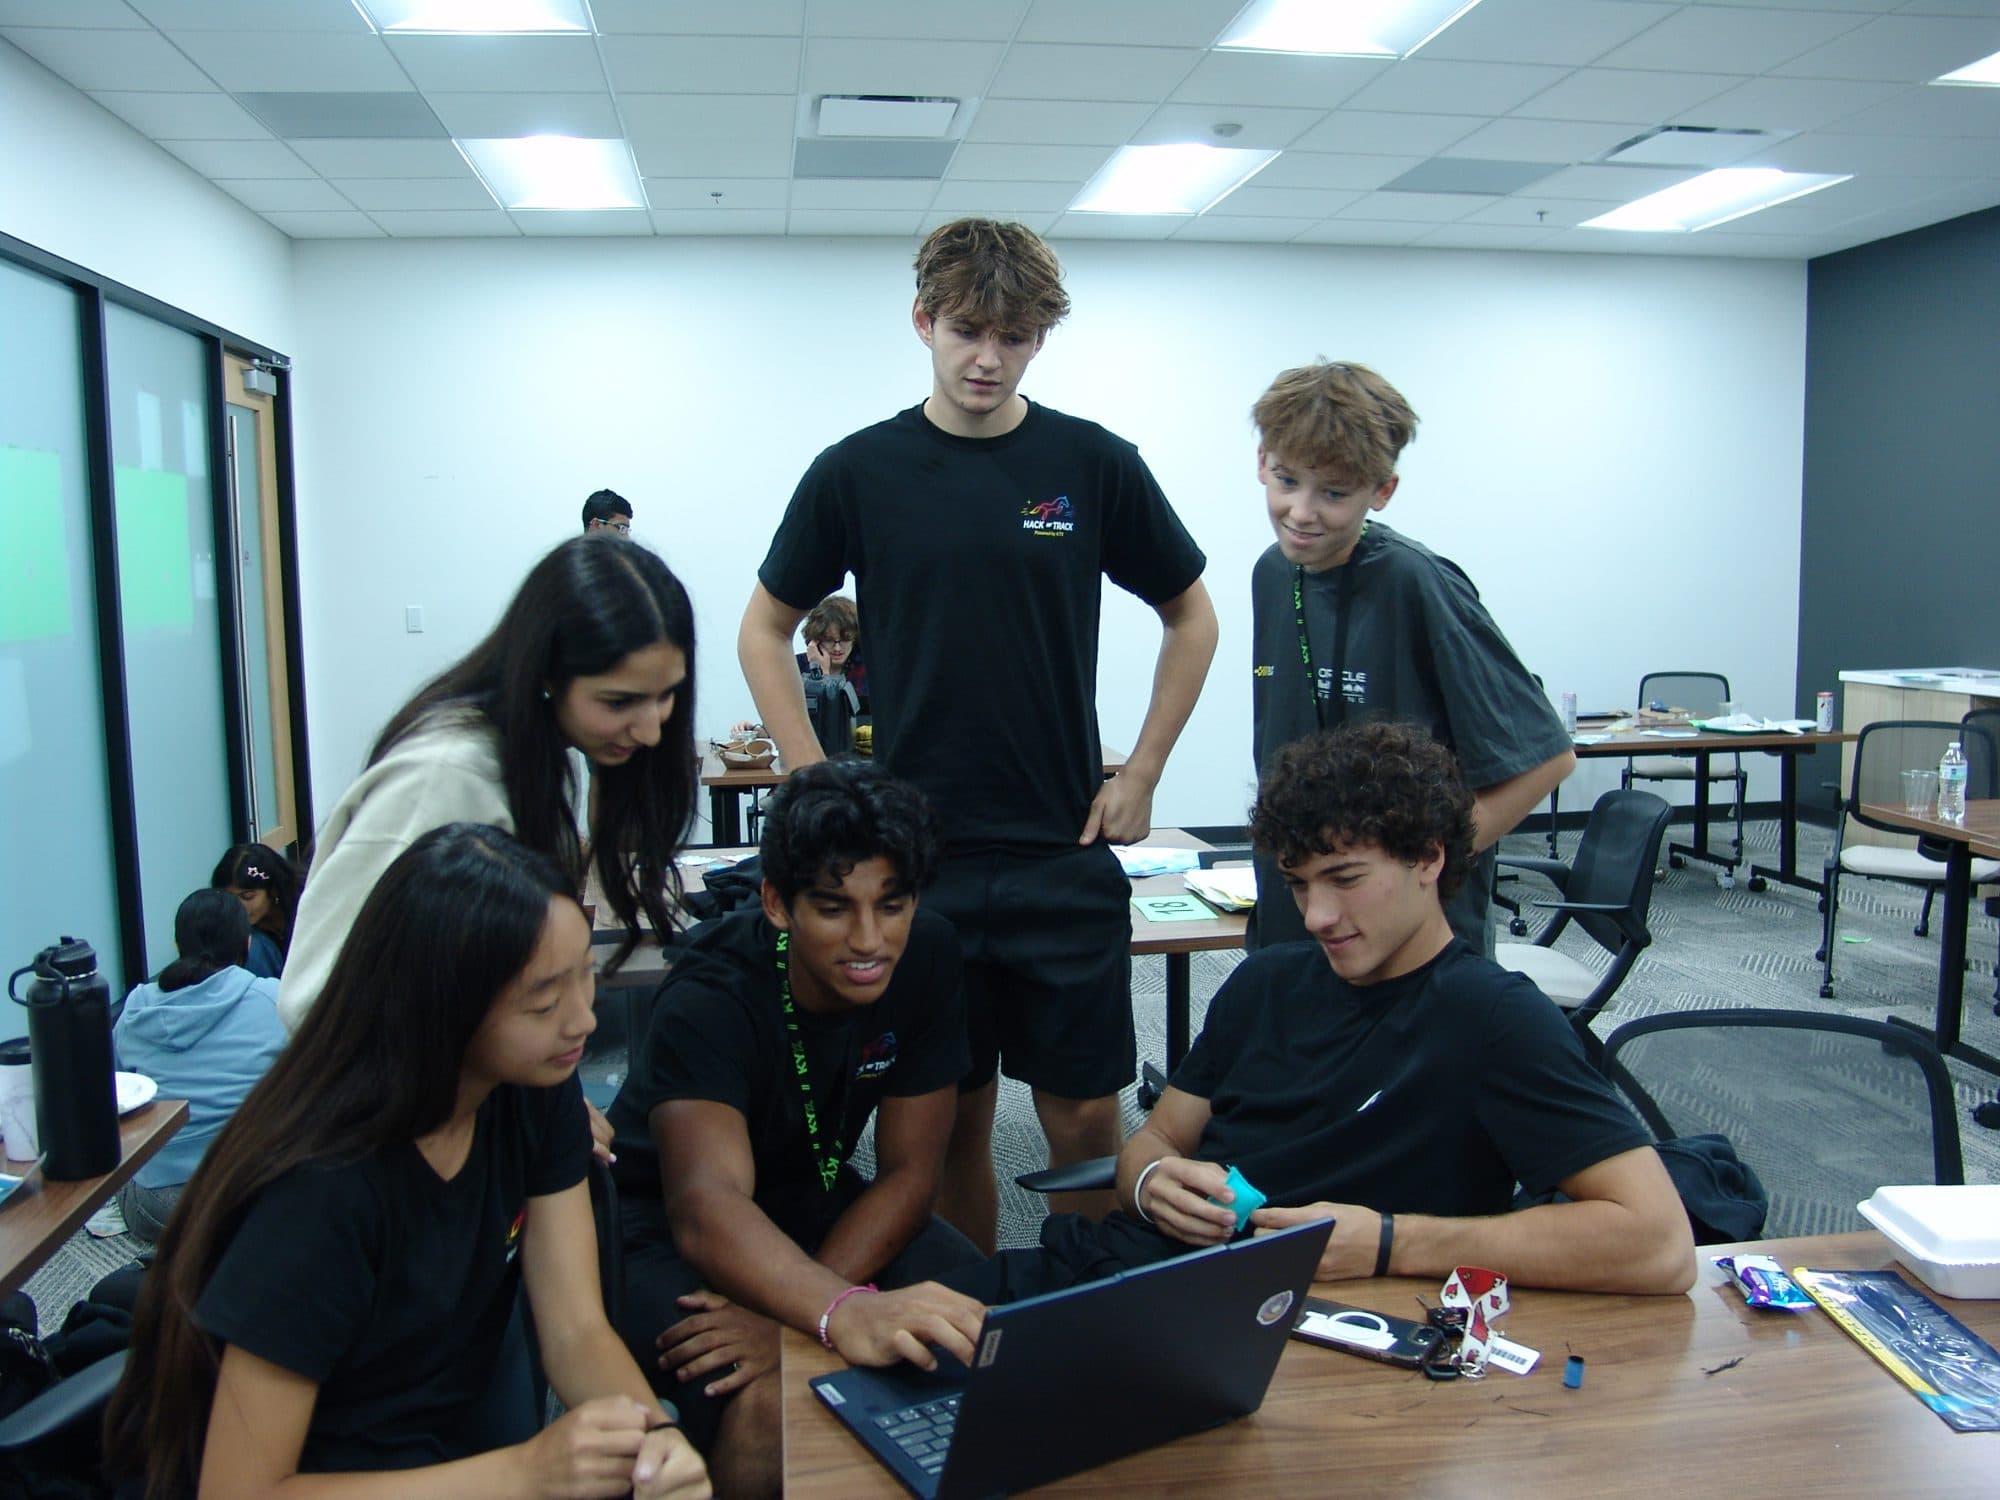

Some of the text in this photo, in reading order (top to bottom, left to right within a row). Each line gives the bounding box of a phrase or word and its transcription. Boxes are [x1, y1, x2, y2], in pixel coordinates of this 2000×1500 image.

[1023, 520, 1045, 529] HACK
[1053, 521, 1074, 531] TRACK
[1318, 668, 1367, 683] ORCLE
[1148, 901, 1194, 915] 18
[776, 931, 789, 951] KY
